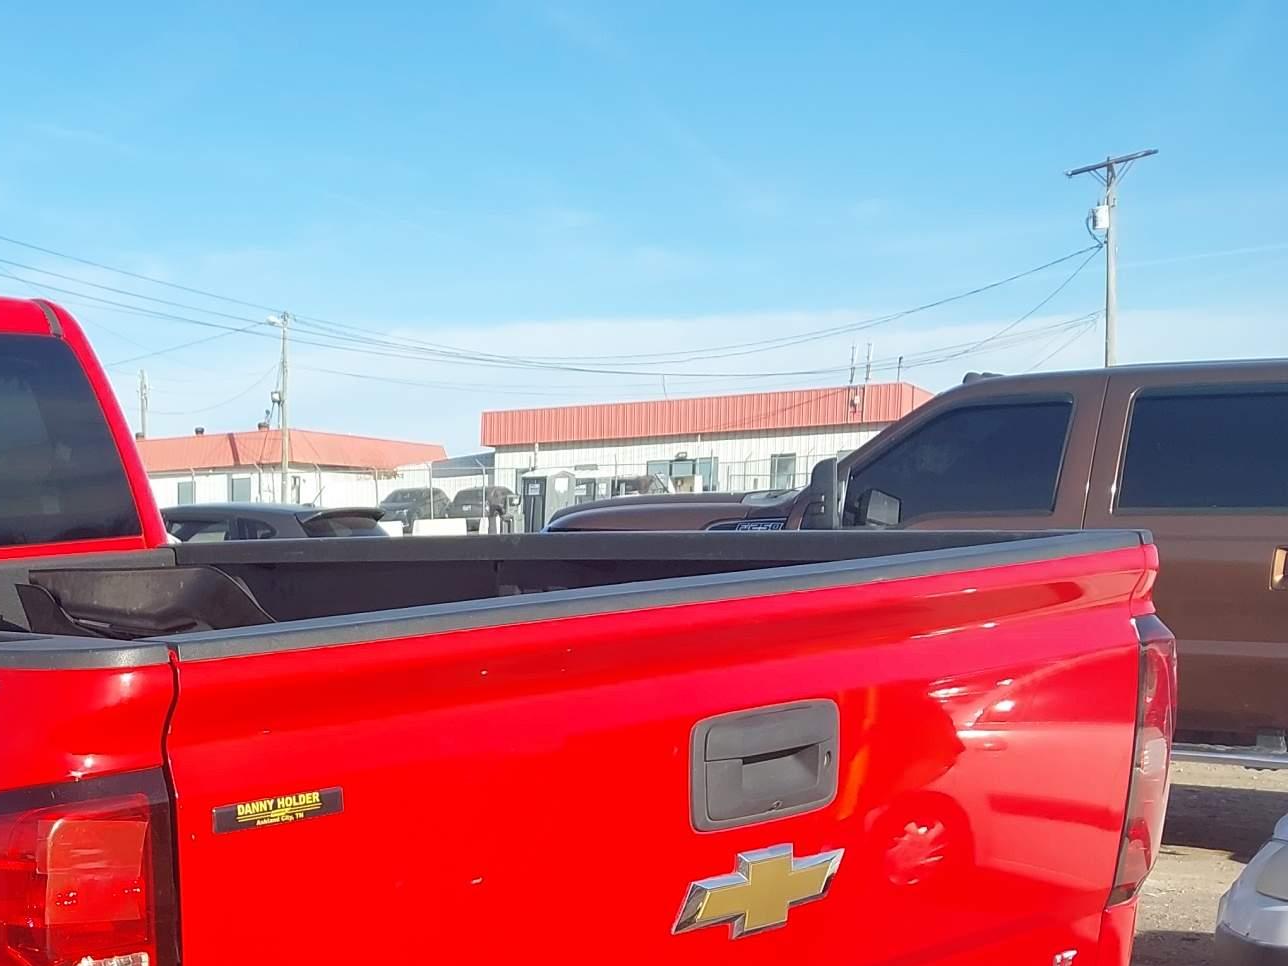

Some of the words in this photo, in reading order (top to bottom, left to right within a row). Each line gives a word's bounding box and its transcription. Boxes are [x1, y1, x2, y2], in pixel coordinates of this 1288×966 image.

[237, 799, 274, 816] DANNY
[277, 792, 320, 809] HOLDER
[256, 816, 281, 826] Ashland
